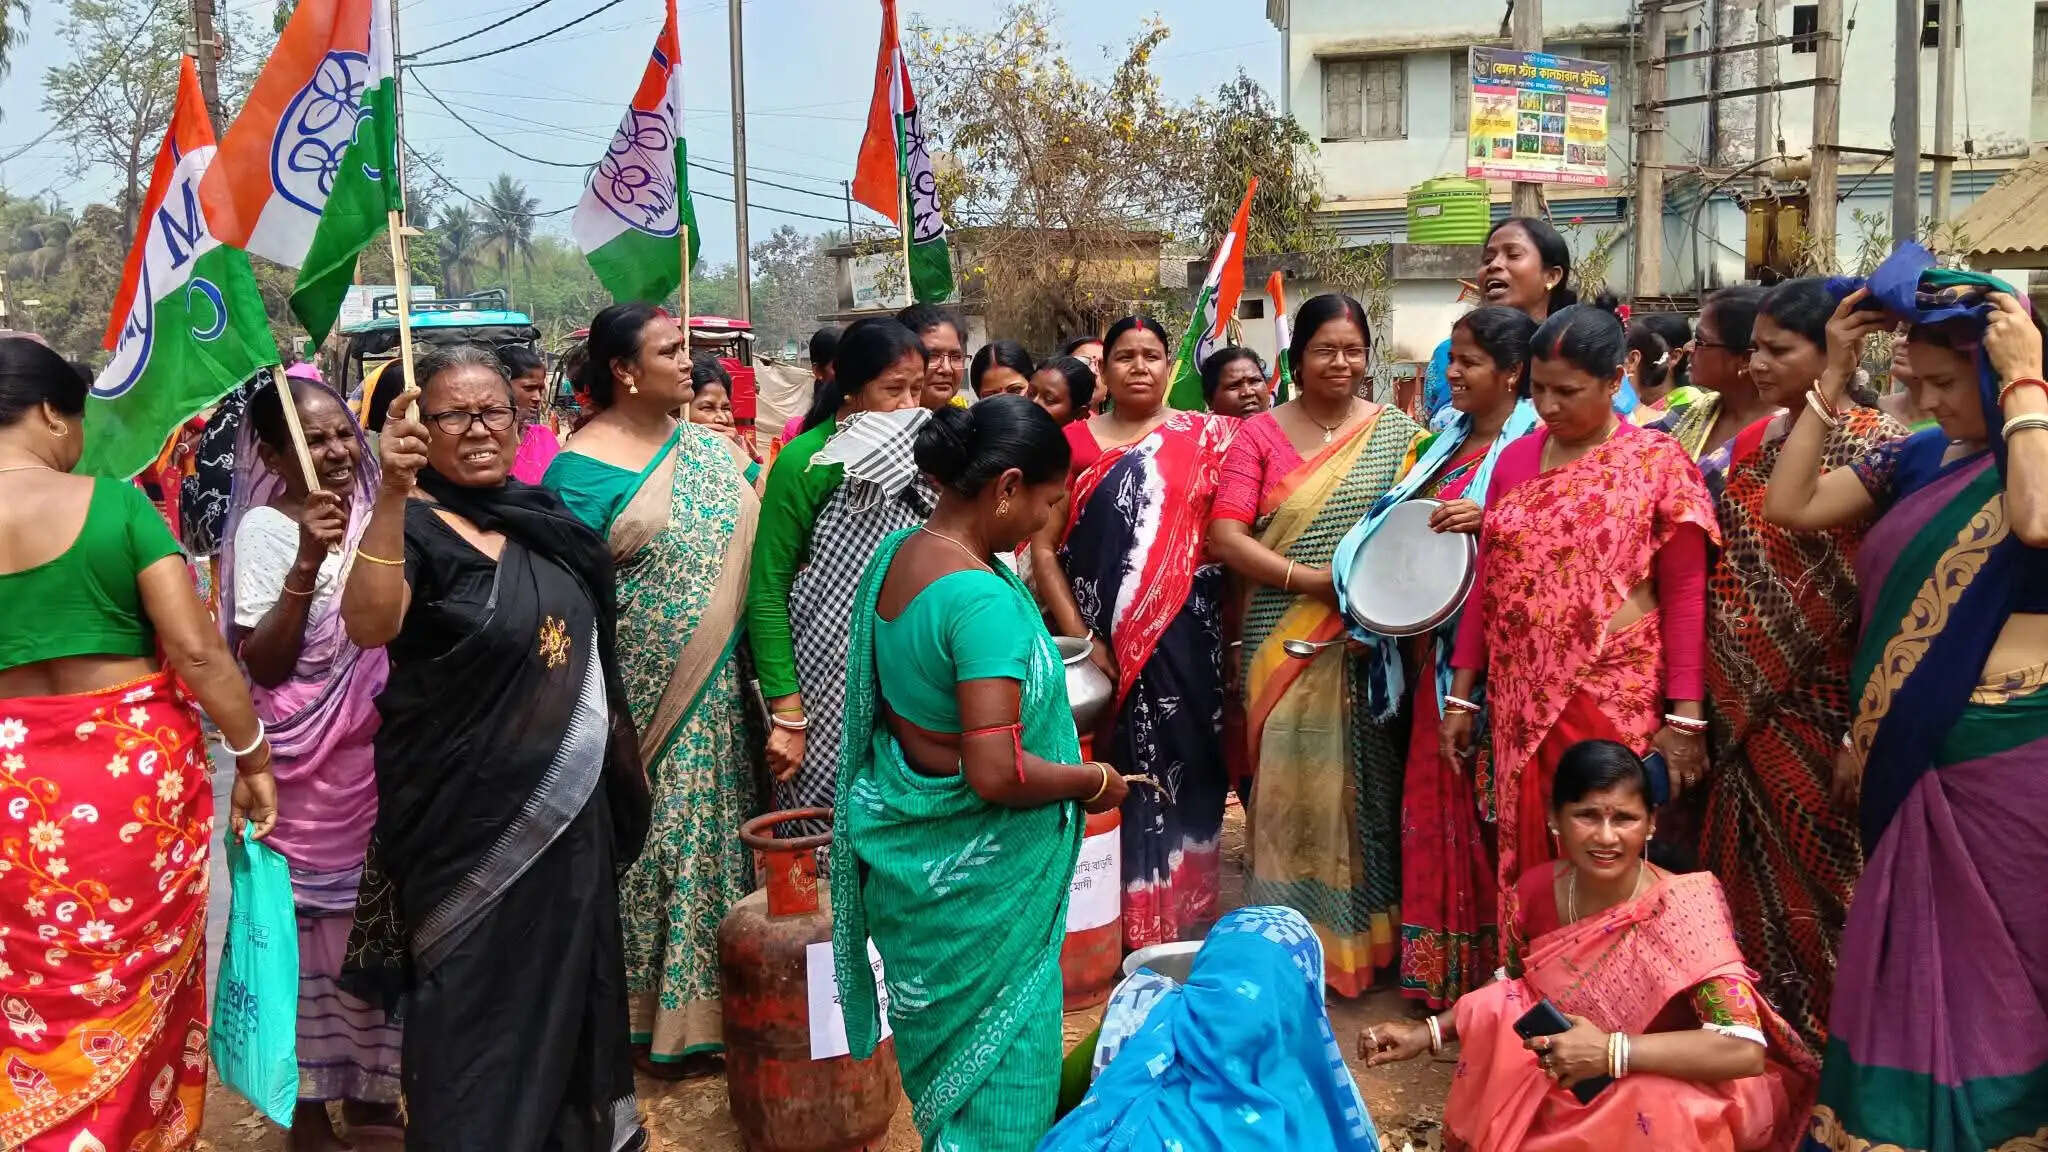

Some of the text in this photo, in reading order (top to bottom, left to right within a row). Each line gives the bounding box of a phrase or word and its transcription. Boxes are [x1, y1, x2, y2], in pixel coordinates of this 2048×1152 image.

[1519, 62, 1537, 78] স্টার
[1539, 67, 1579, 82] কালচারাল
[1580, 70, 1606, 88] স্টুডিও
